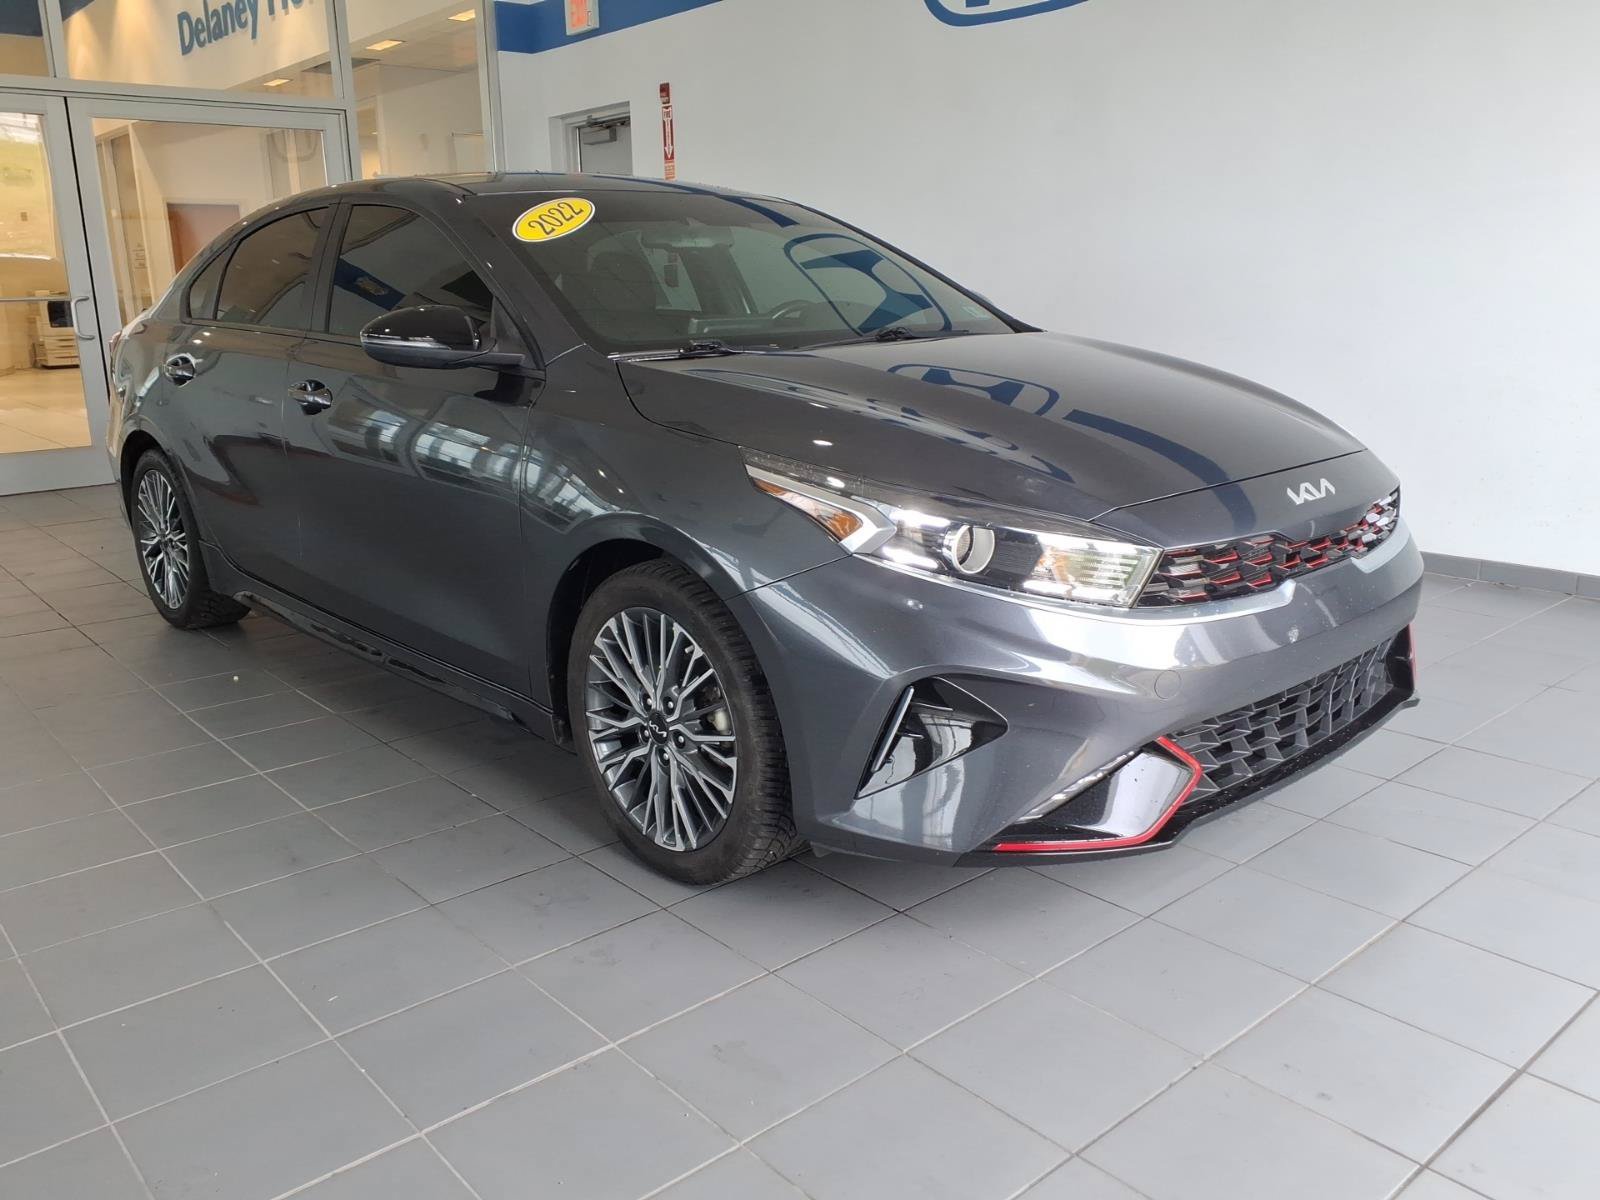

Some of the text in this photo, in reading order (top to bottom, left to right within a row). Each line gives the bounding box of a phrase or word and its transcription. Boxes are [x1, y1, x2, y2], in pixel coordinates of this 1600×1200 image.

[177, 0, 259, 56] Delaney
[528, 202, 584, 235] 2022
[1286, 478, 1336, 505] KIA
